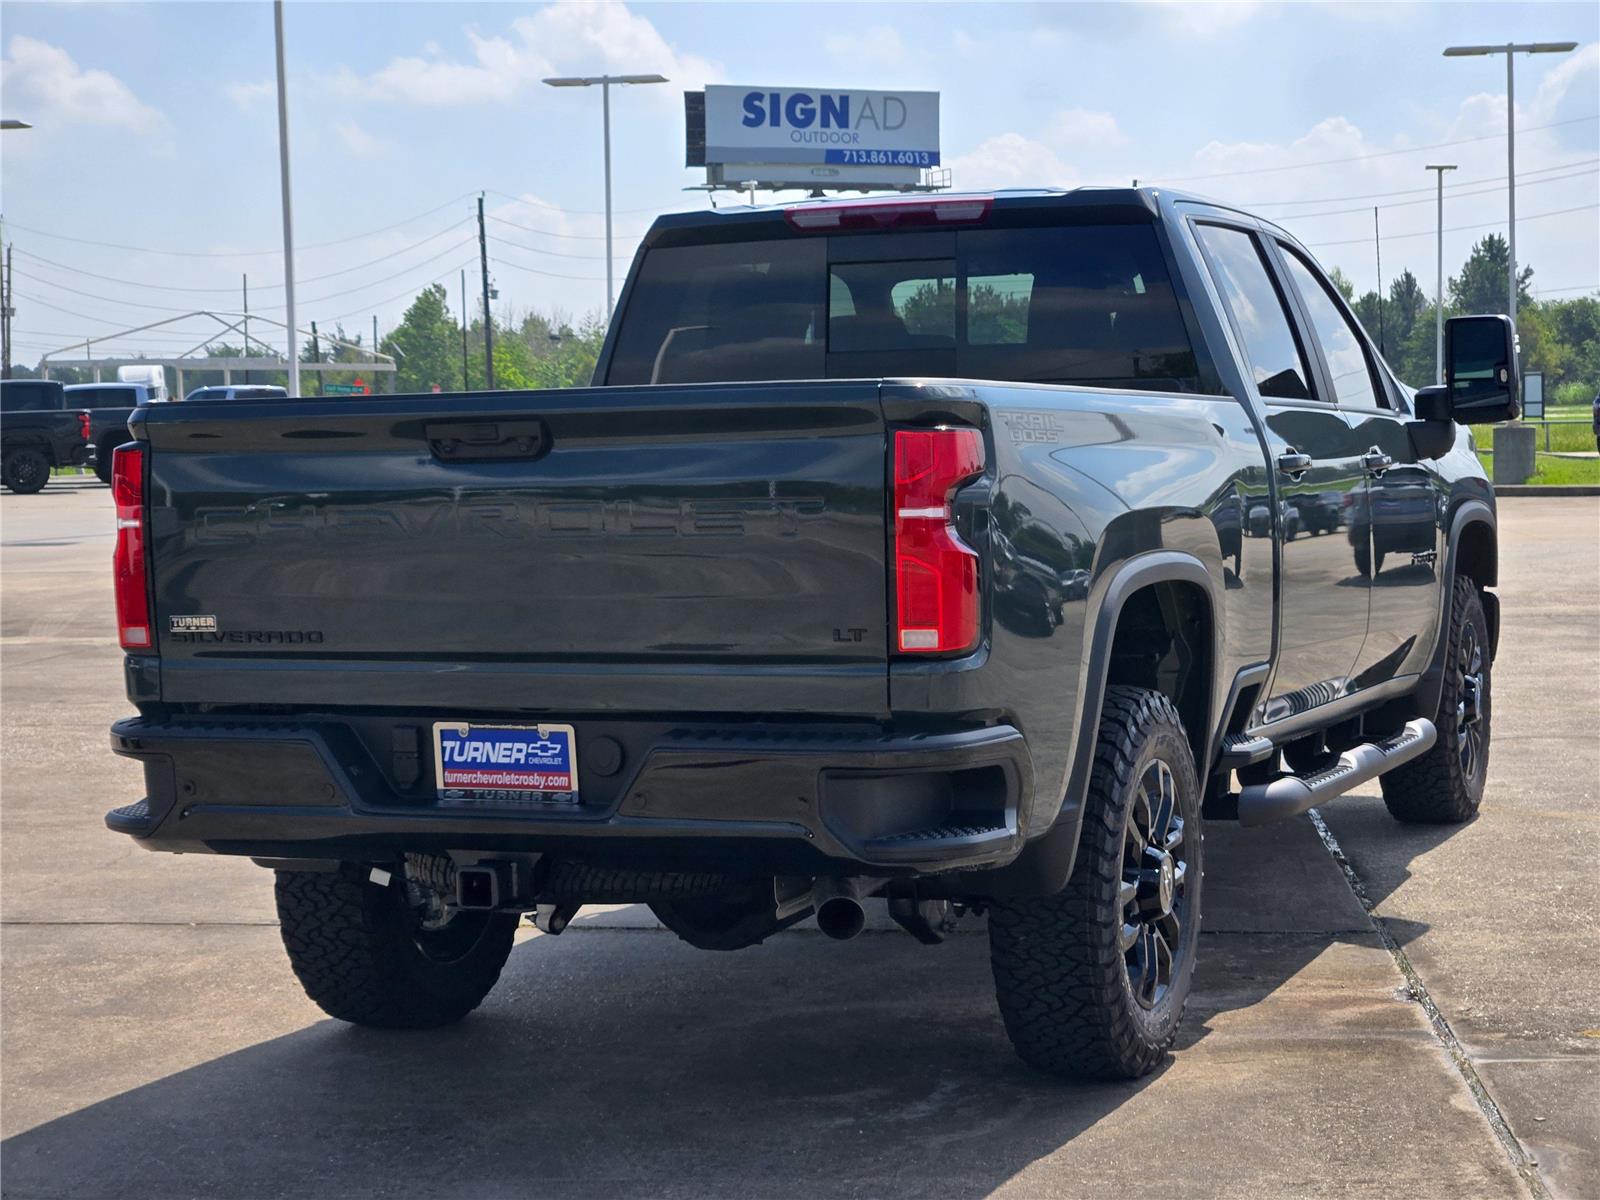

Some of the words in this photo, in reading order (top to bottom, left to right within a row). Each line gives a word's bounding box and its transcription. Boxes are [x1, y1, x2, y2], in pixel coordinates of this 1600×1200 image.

[790, 130, 859, 144] OUTDOOR
[843, 150, 929, 165] 713.861.6013
[997, 411, 1064, 432] TRAIL
[1010, 430, 1058, 444] BOSS
[171, 617, 214, 627] TURNER
[833, 628, 868, 642] LT
[442, 741, 527, 764] TURNER
[528, 757, 562, 765] CHEVROLET
[444, 771, 568, 788] turnerchevroletcrosby.com
[471, 789, 543, 801] TURNER
